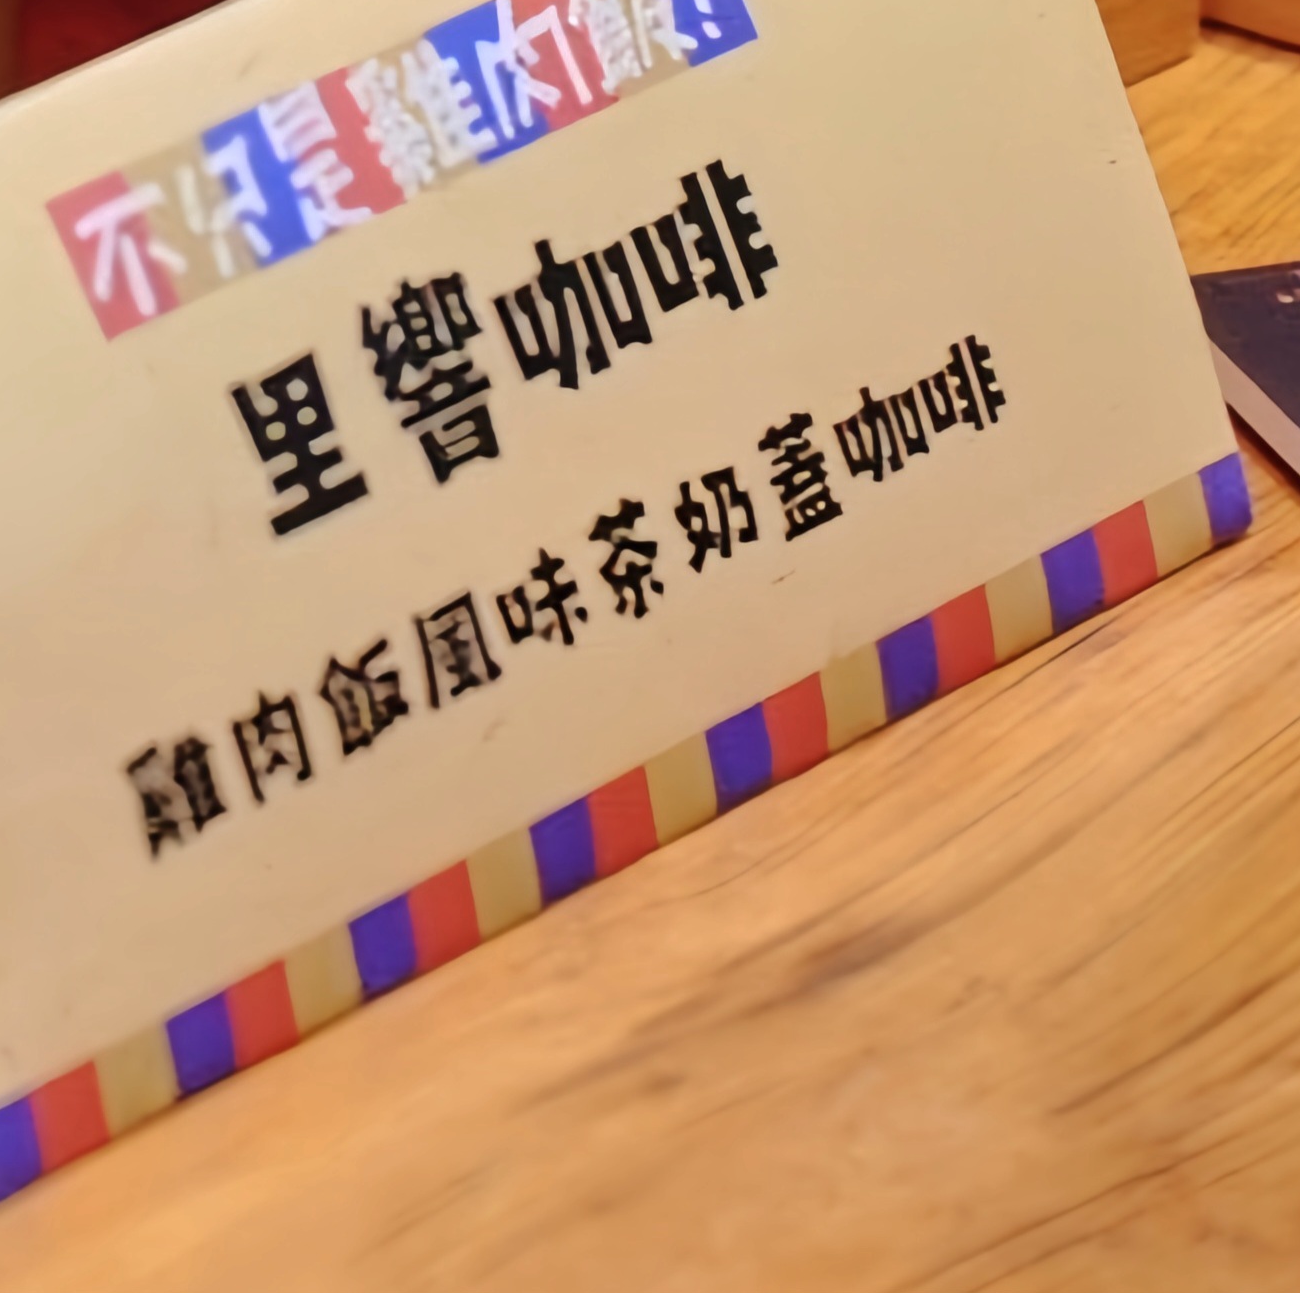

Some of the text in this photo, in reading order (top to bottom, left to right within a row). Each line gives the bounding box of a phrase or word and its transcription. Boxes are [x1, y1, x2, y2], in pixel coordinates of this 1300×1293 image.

[230, 158, 779, 537] 里響咖啡
[126, 334, 1007, 861] 雞肉飯風味茶奶蓋咖啡
